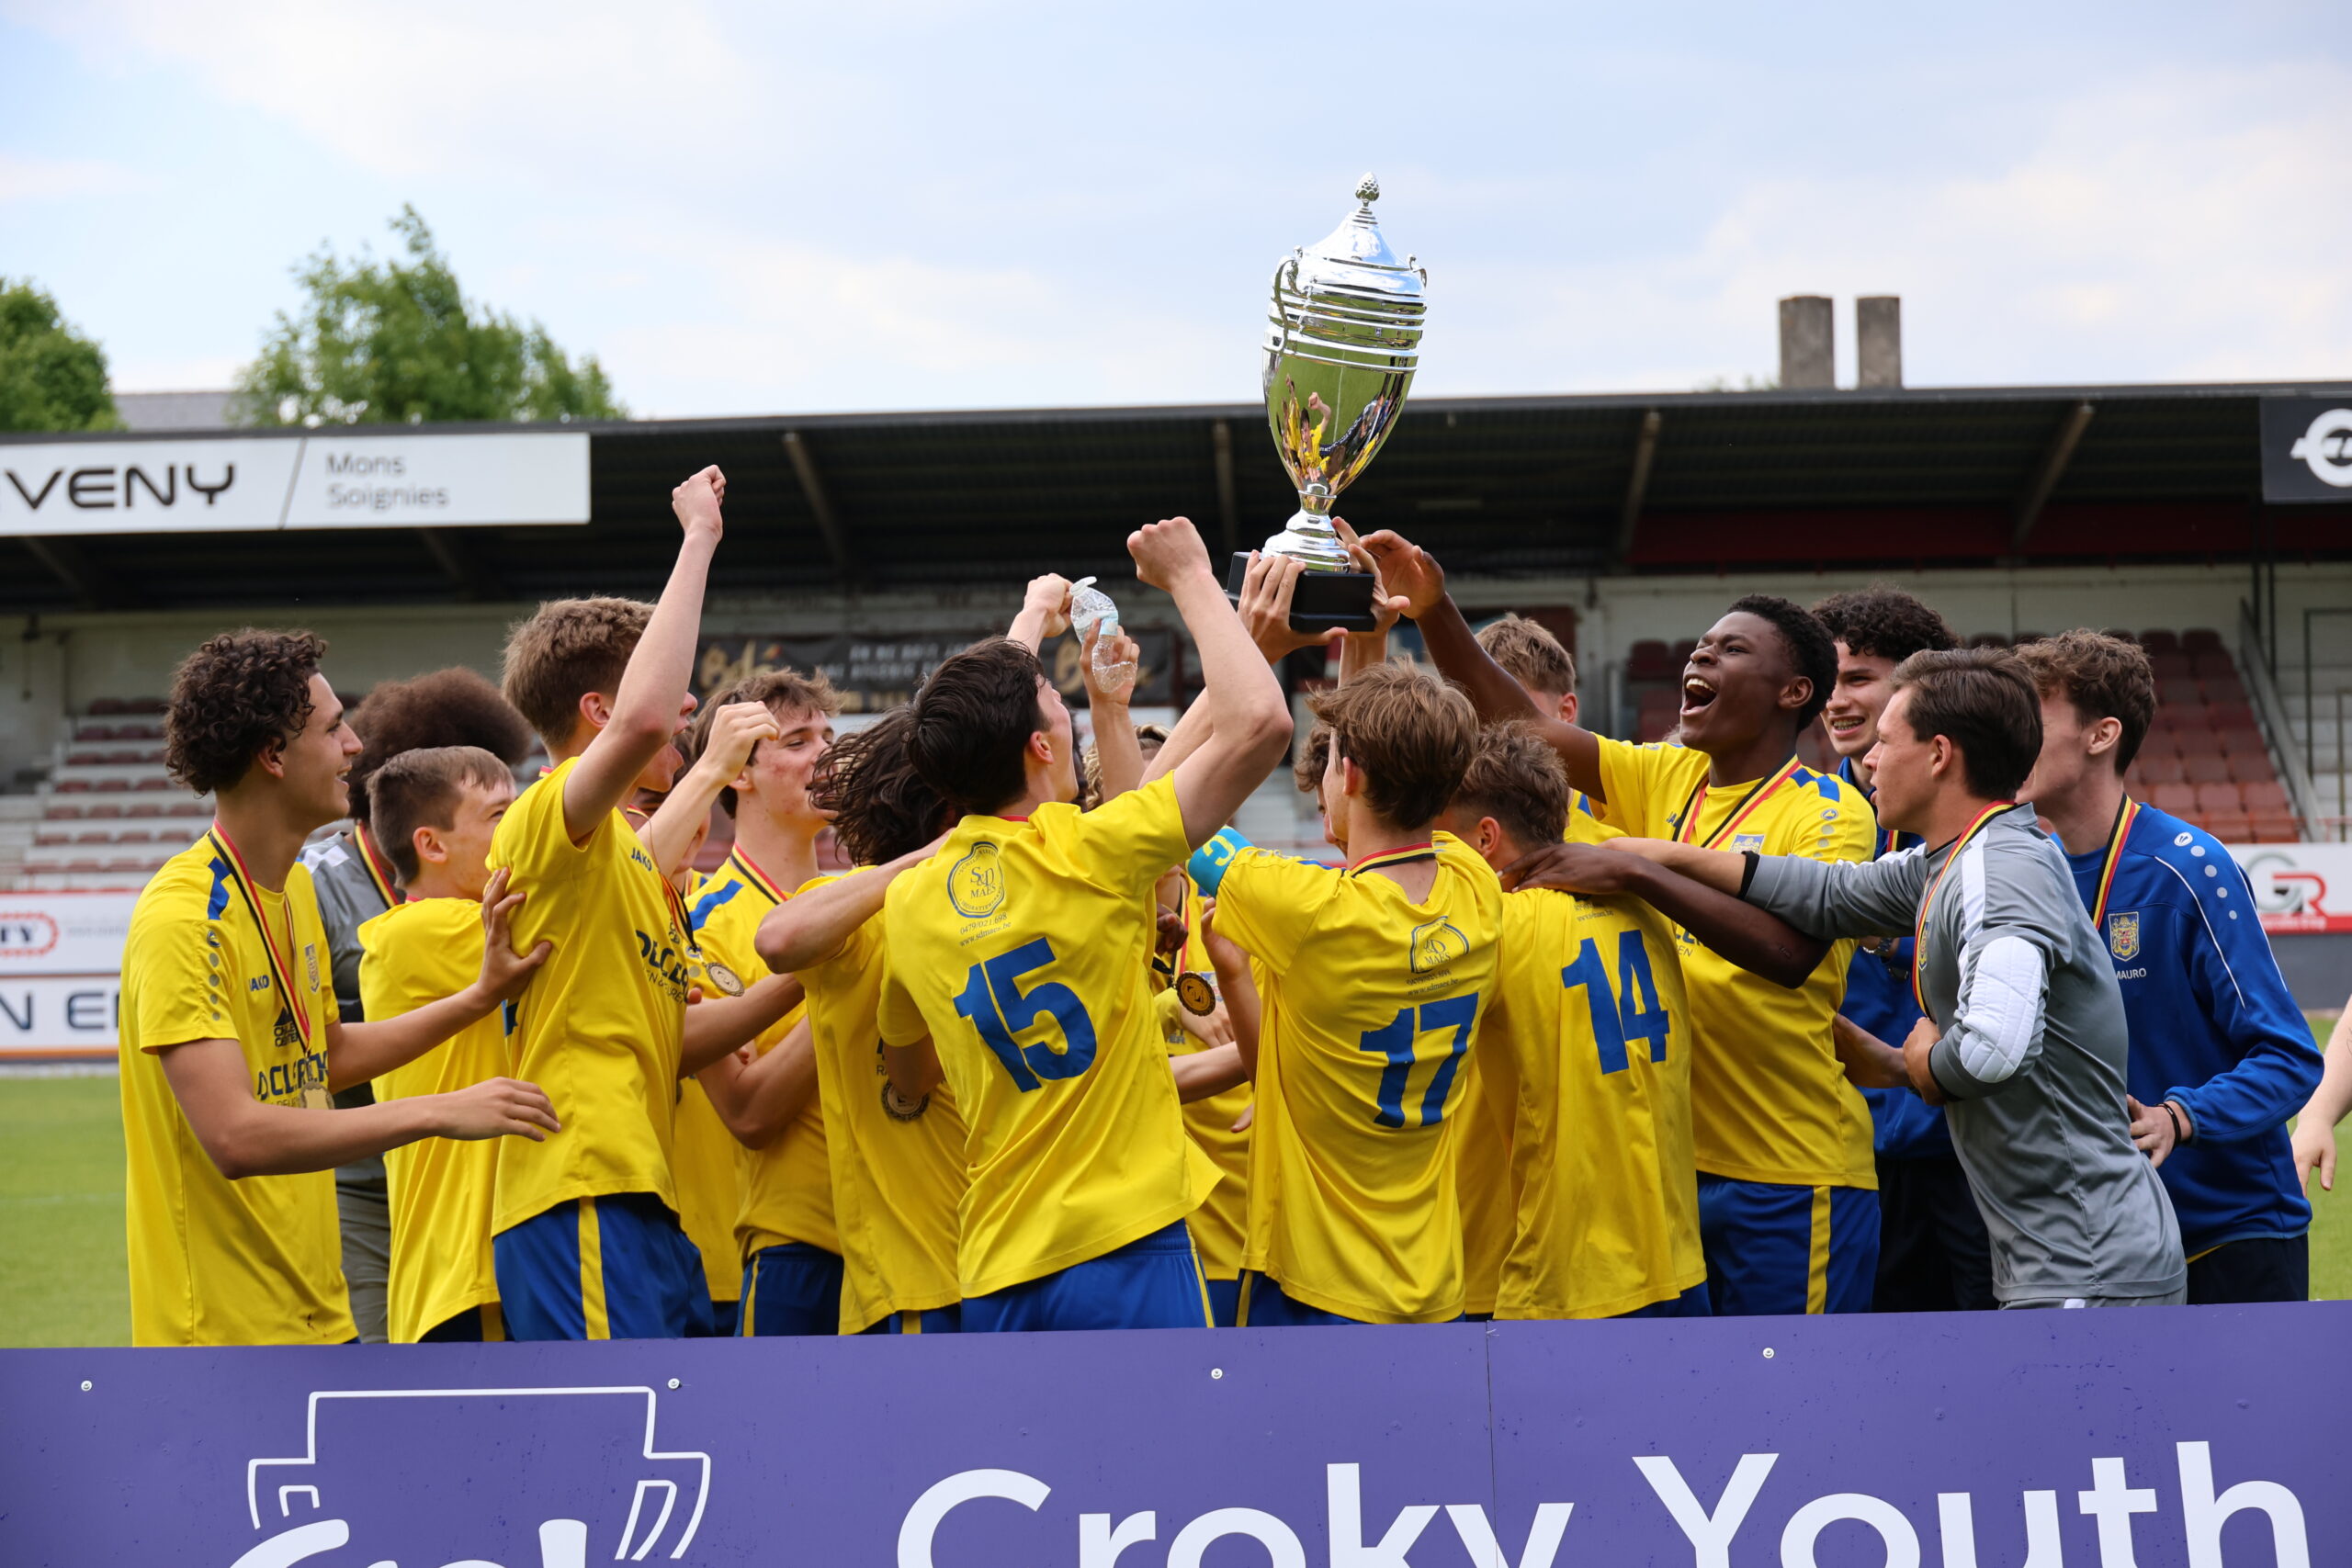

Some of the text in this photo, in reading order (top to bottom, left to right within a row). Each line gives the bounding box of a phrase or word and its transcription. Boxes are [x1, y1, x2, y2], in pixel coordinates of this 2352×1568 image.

[326, 453, 406, 477] Mons
[328, 483, 448, 513] Soignies
[970, 884, 996, 898] MAES
[953, 936, 1097, 1093] 15
[1360, 992, 1479, 1128] 17
[1562, 930, 1670, 1076] 14
[1632, 1440, 2311, 1568] Youth
